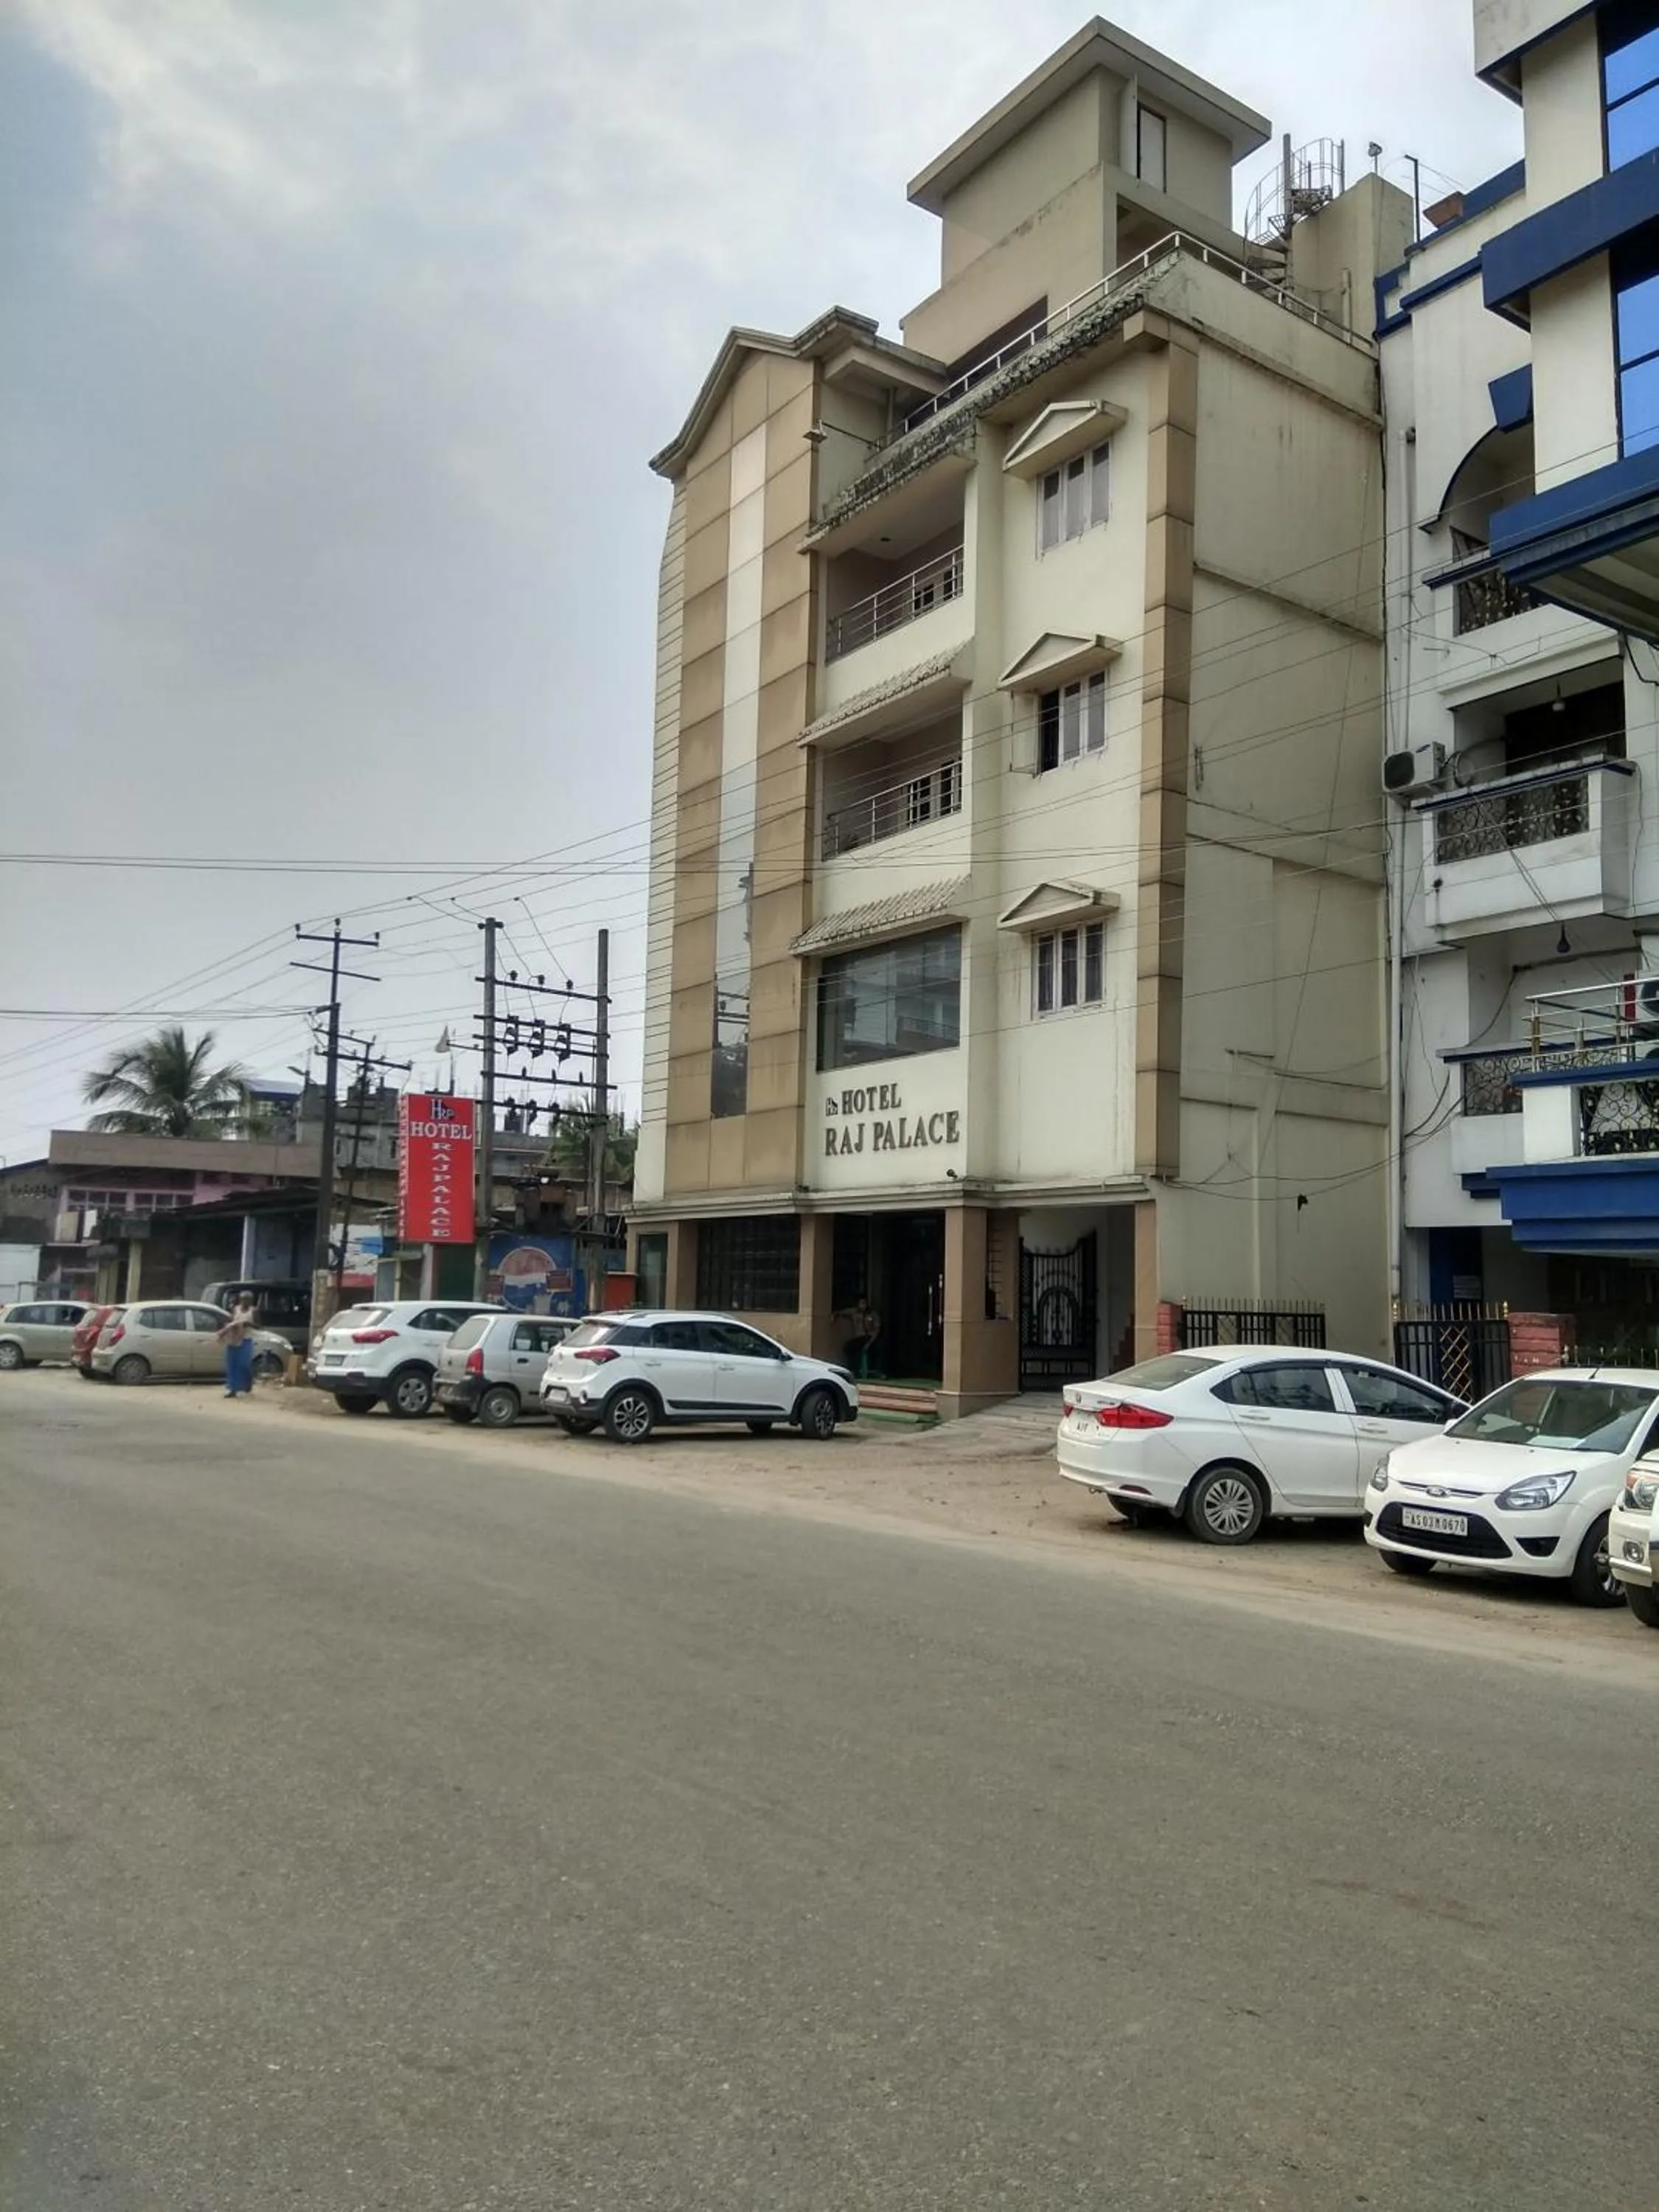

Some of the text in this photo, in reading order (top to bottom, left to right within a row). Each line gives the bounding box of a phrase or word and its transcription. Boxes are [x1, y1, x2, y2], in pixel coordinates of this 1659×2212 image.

[841, 1083, 901, 1115] HOTEL
[411, 1121, 473, 1139] HOTEL
[825, 1110, 959, 1155] RAJ PALACE
